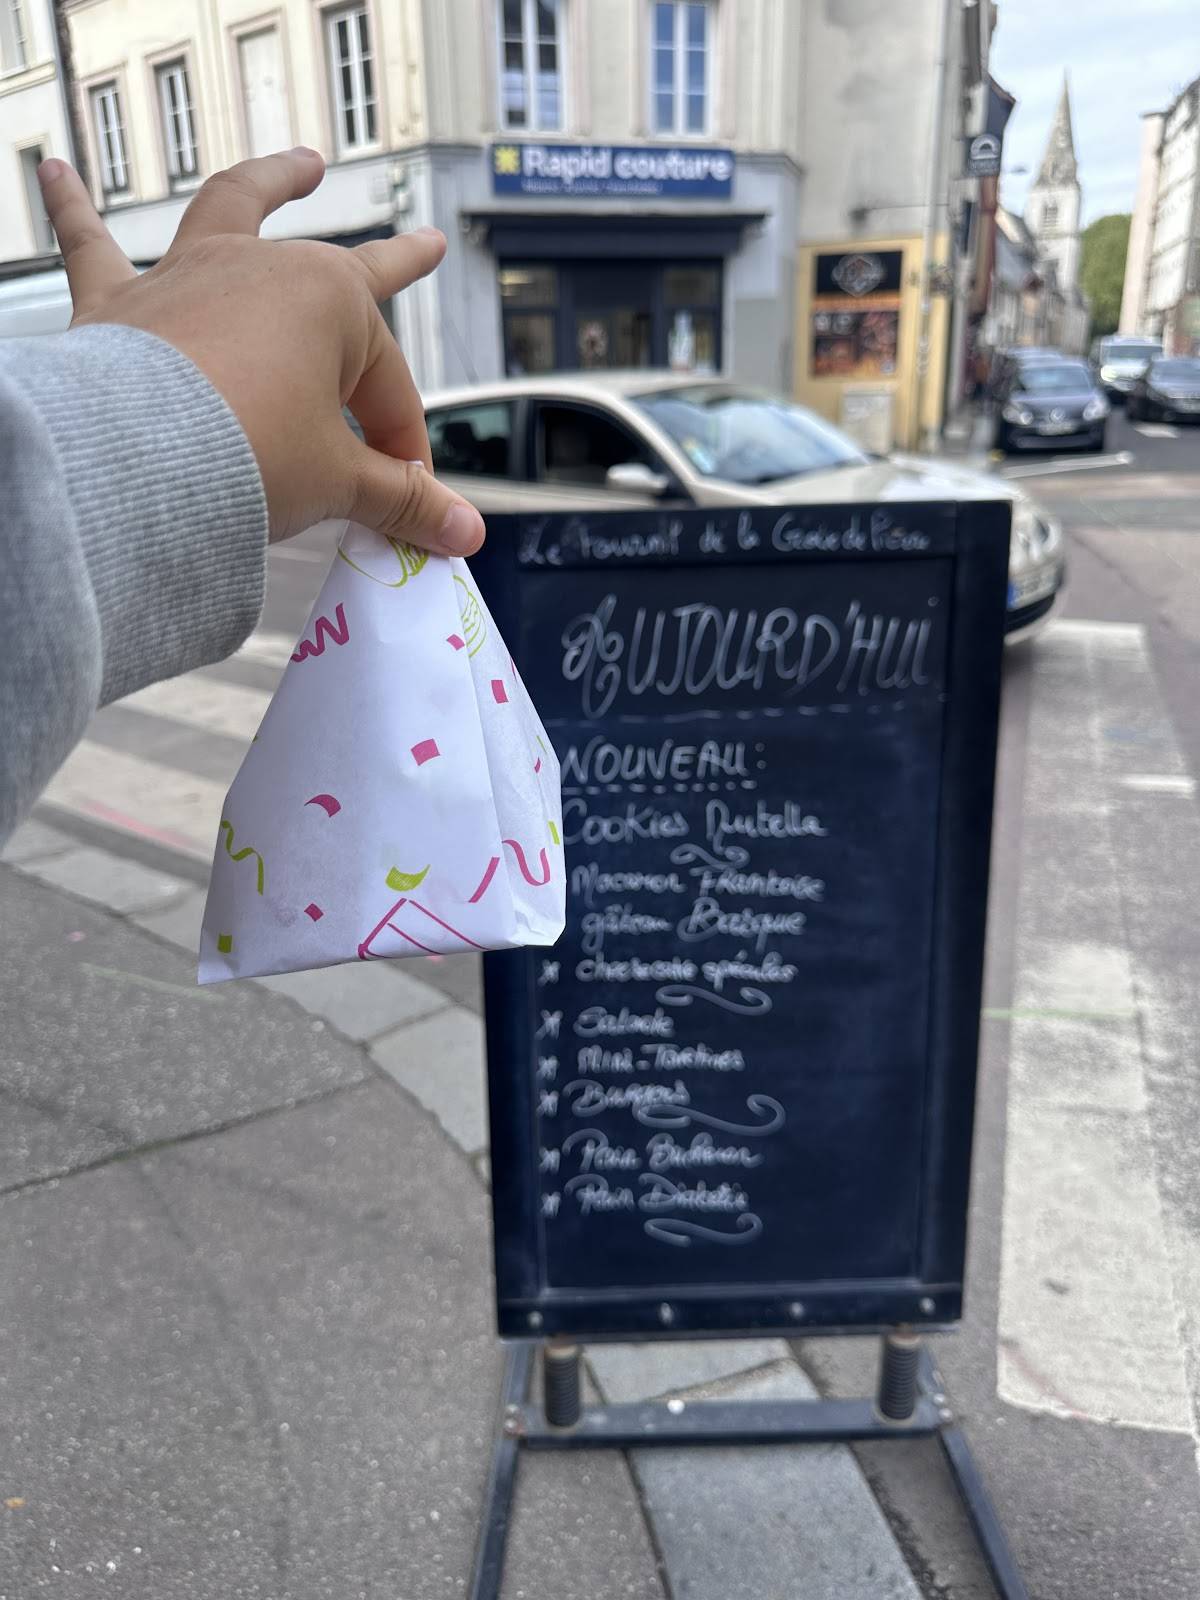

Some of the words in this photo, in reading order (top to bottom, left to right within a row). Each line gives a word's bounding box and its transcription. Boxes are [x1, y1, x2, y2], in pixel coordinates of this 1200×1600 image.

[523, 147, 613, 184] Rapid
[614, 151, 734, 181] couture
[563, 798, 689, 845] Cookies
[706, 800, 828, 855] Nutella
[571, 862, 688, 908] Macaron
[677, 897, 806, 950] Basque
